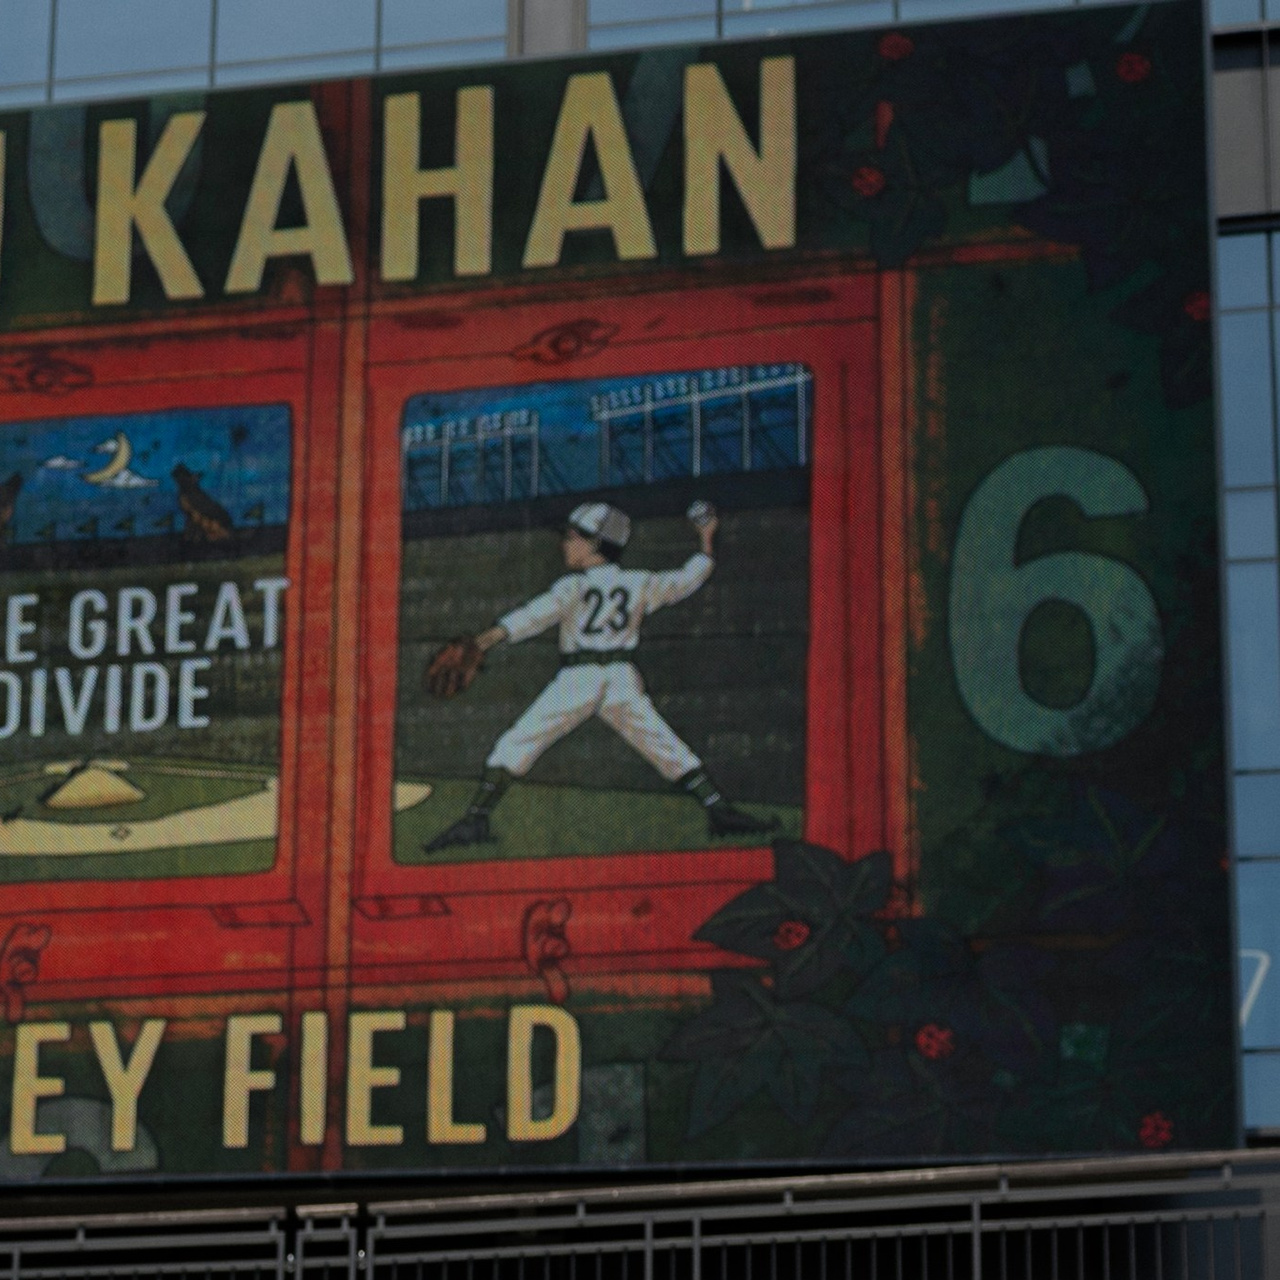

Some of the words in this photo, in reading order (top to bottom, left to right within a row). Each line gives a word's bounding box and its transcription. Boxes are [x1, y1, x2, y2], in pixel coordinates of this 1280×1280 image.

[91, 55, 797, 306] KAHAN
[68, 577, 291, 660] GREAT
[584, 588, 630, 635] 23
[948, 445, 1165, 757] 6
[221, 1005, 582, 1149] FIELD
